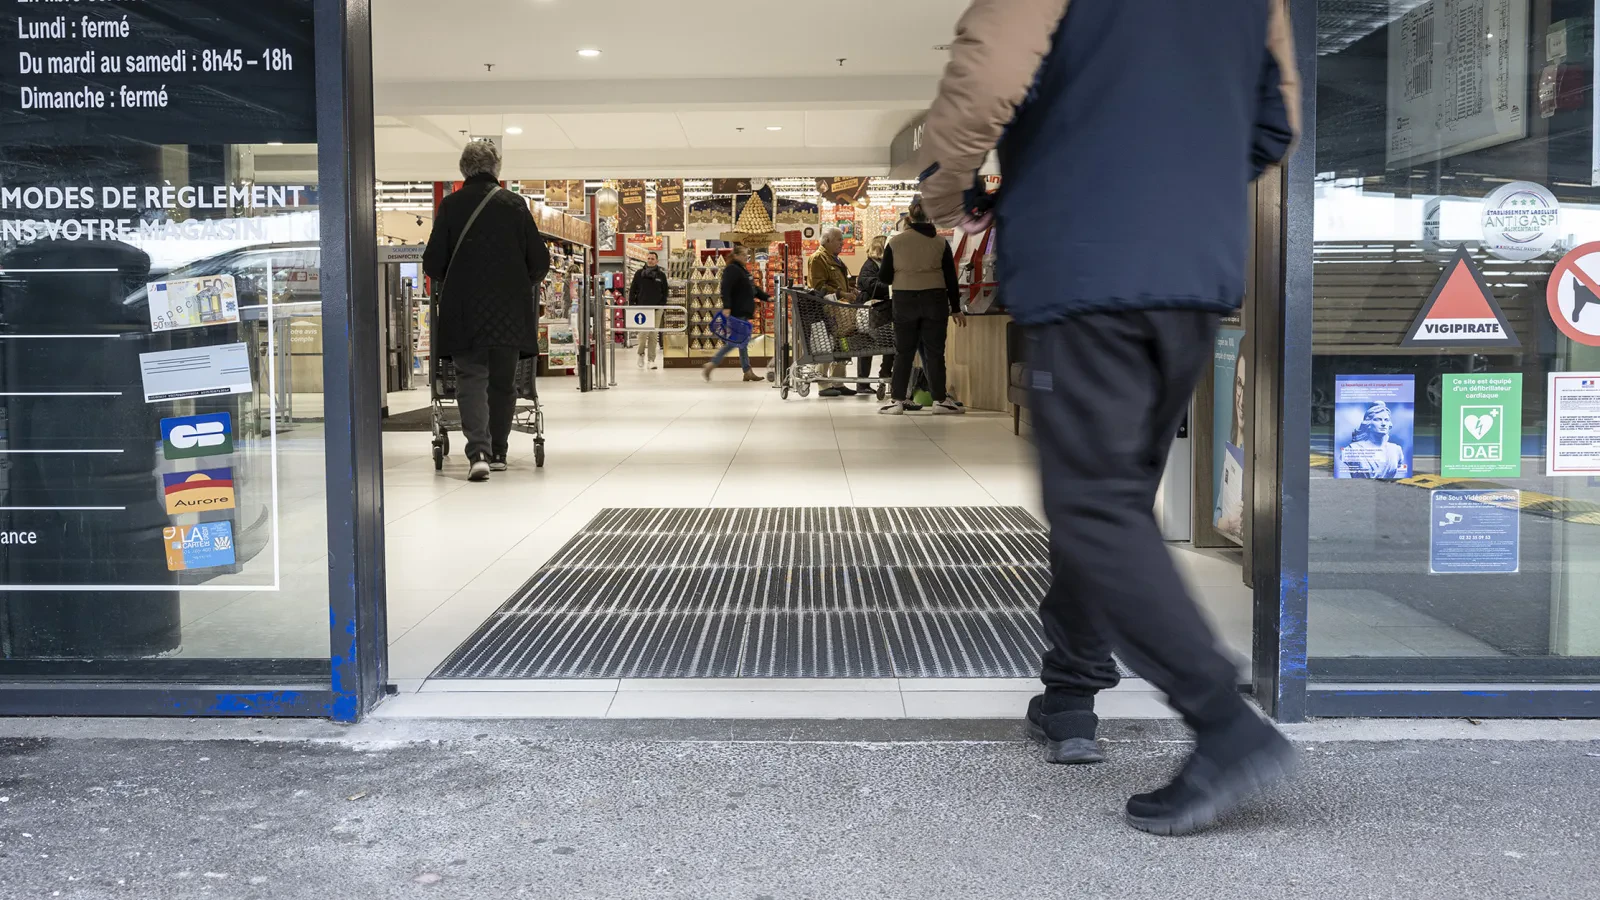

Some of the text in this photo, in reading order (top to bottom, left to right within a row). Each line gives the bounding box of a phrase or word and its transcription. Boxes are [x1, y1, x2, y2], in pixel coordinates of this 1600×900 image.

[18, 16, 66, 39] Lundi
[81, 15, 130, 38] fermé
[19, 51, 43, 74] Du
[47, 50, 96, 74] mardi
[100, 56, 121, 73] au
[125, 49, 187, 73] samedi
[202, 48, 243, 72] 8h45
[262, 48, 293, 71] 18h
[20, 85, 105, 109] Dimanche
[120, 84, 169, 108] fermé
[1, 179, 305, 210] MODES DE RÈGLEMENT
[1484, 214, 1558, 228] ANTIGASPI
[0, 218, 264, 241] NS VOTRE MAGASIN
[1425, 323, 1499, 334] VIGIPIRATE
[1489, 377, 1512, 386] équipé
[169, 421, 226, 449] CB
[1463, 445, 1499, 459] DAE
[174, 496, 229, 508] Aurore
[1464, 494, 1516, 502] Vidéoprotection
[0, 531, 37, 545] ance
[180, 527, 204, 543] LA
[182, 541, 205, 549] CARTE
